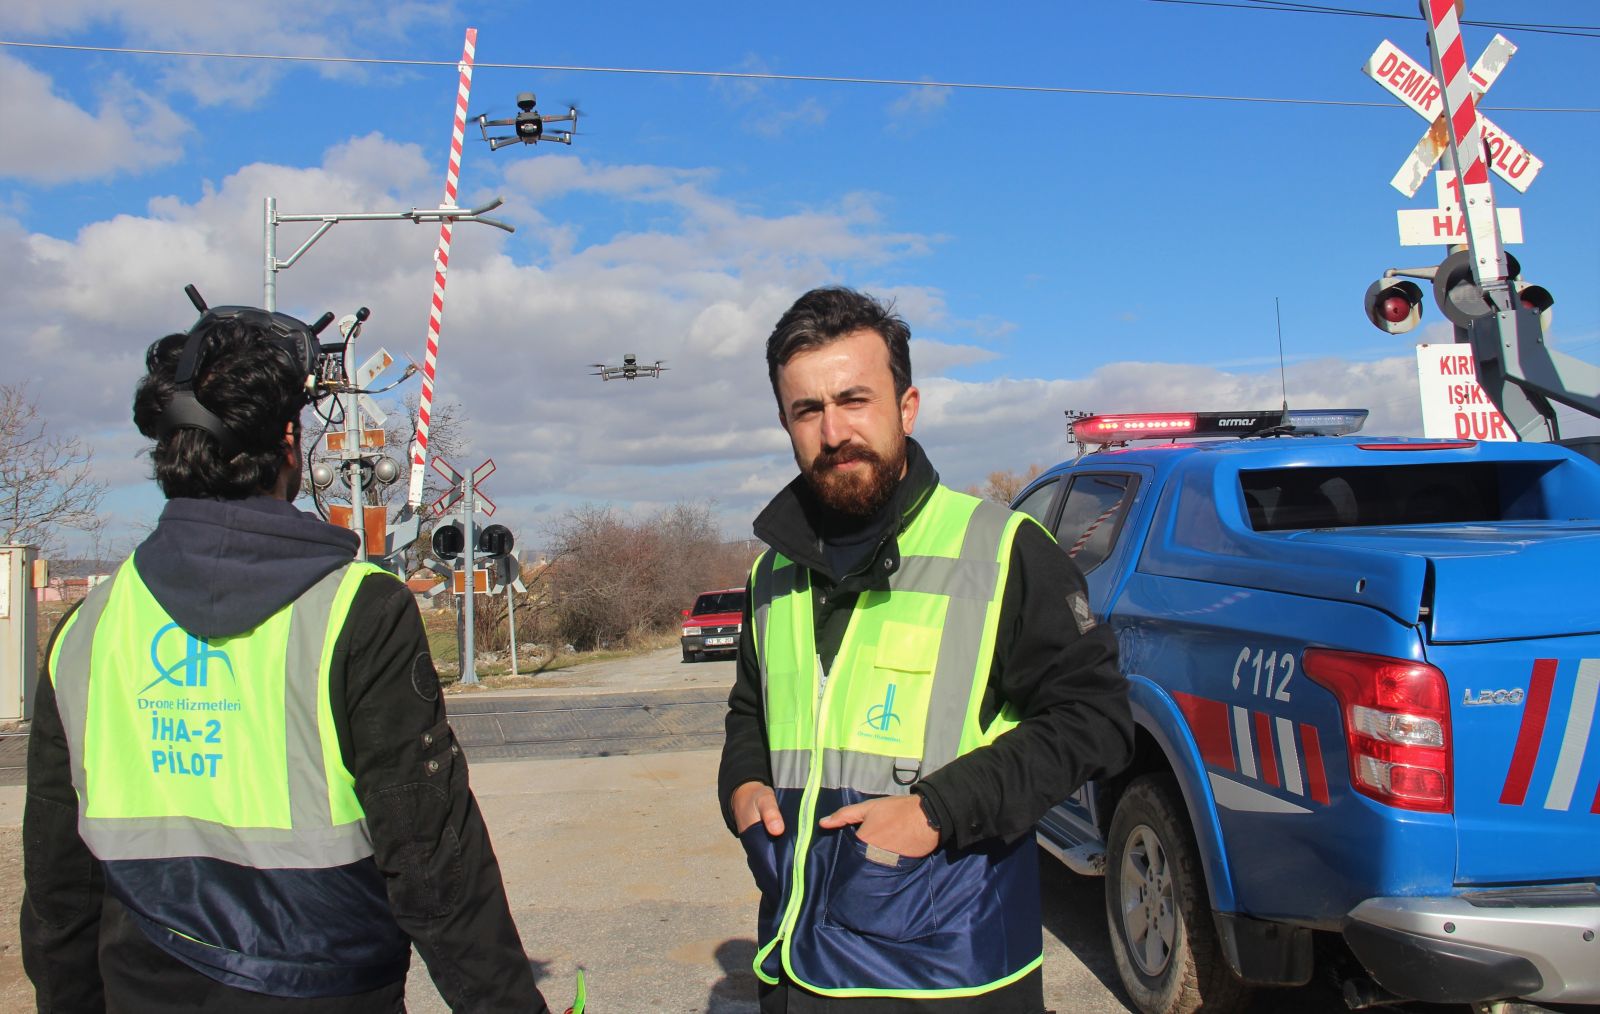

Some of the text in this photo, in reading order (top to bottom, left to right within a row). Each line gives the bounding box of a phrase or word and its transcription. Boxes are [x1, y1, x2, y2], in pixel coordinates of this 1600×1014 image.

[1376, 52, 1441, 112] DEMİR
[1454, 411, 1508, 440] DUR
[1252, 648, 1295, 703] 112
[137, 697, 241, 712] Drone Hizmetleri
[1463, 688, 1525, 706] L200
[151, 710, 222, 743] İHA-2
[151, 744, 223, 778] PİLOT
